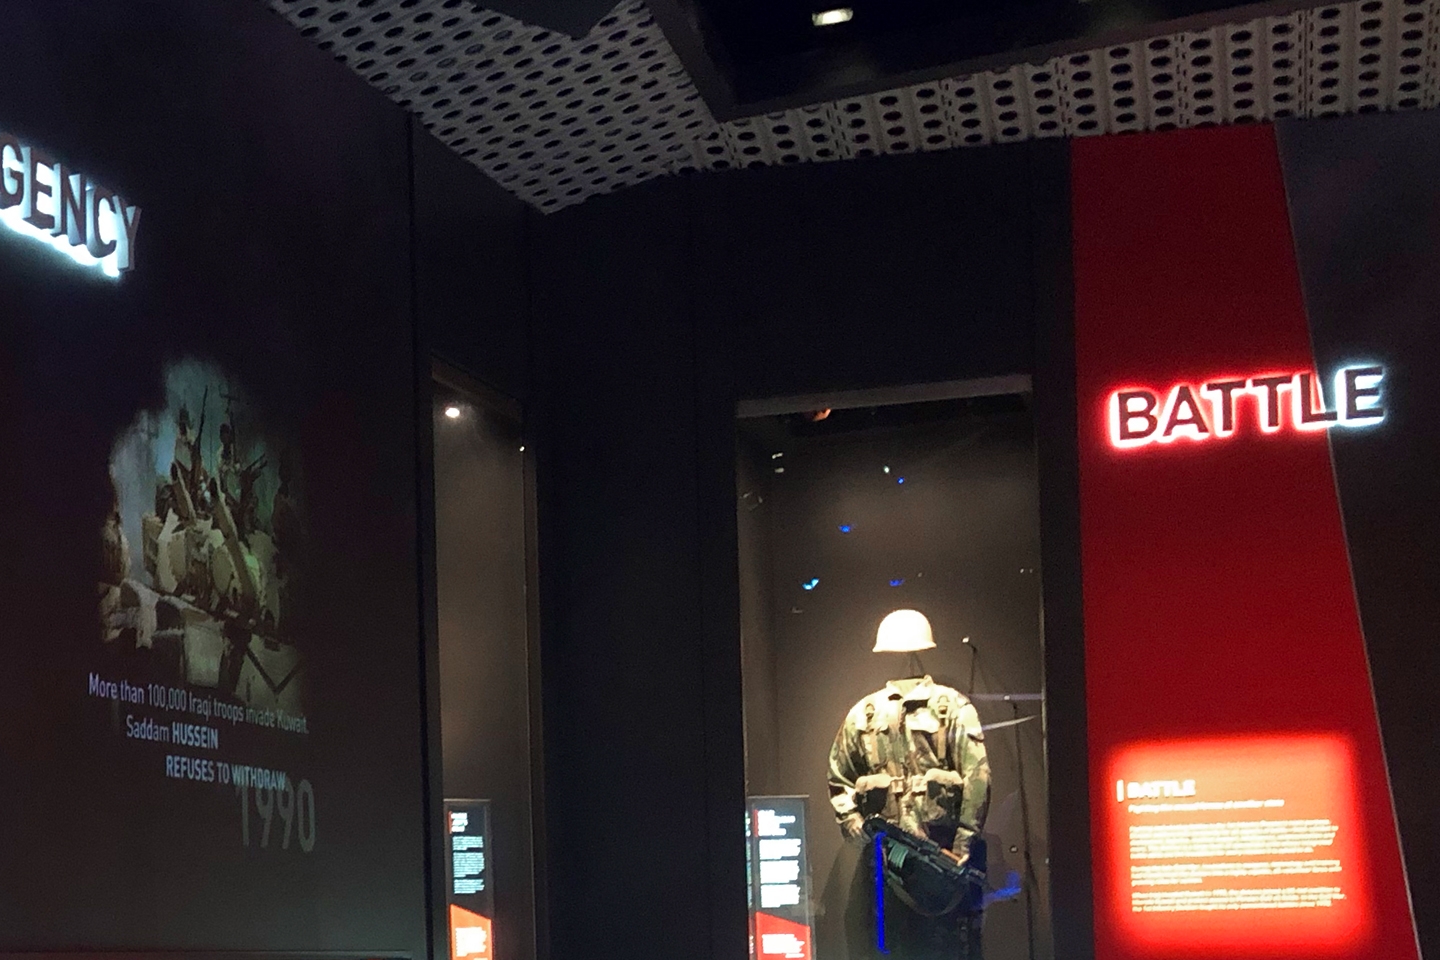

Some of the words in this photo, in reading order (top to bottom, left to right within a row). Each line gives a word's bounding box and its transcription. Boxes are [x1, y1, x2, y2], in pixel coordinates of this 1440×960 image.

[1111, 365, 1386, 446] BATTLE
[88, 672, 117, 699] More
[120, 680, 144, 705] than
[148, 683, 186, 712] 100,000
[189, 691, 211, 722] Iraqi
[213, 697, 244, 726] troops
[246, 704, 275, 728] invade
[126, 714, 169, 742] Saddam
[171, 721, 219, 750] HUSSEIN
[165, 754, 214, 783] REFUSES
[216, 762, 230, 784] TO
[235, 778, 315, 853] 1990
